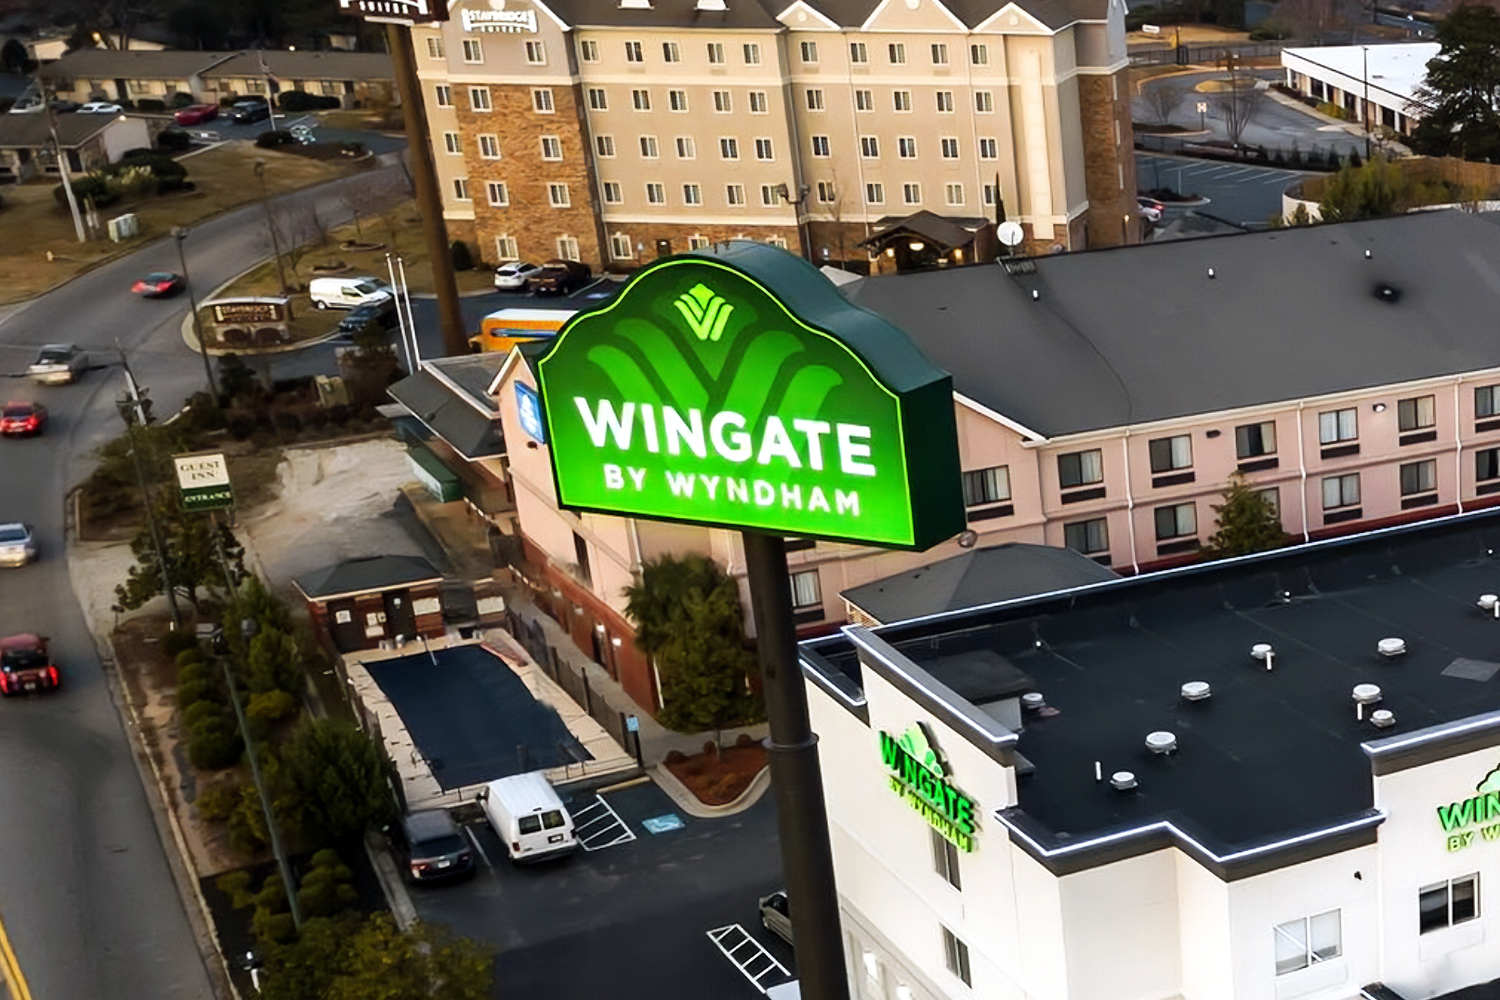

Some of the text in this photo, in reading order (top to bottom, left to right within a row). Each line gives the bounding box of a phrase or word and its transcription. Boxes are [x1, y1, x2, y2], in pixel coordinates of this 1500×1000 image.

[573, 396, 877, 478] WINGATE
[180, 460, 219, 472] GUEST
[191, 471, 215, 480] INN
[603, 463, 861, 517] BY WYNDHAM
[879, 730, 975, 834] WINGATE
[1448, 832, 1474, 852] BY
